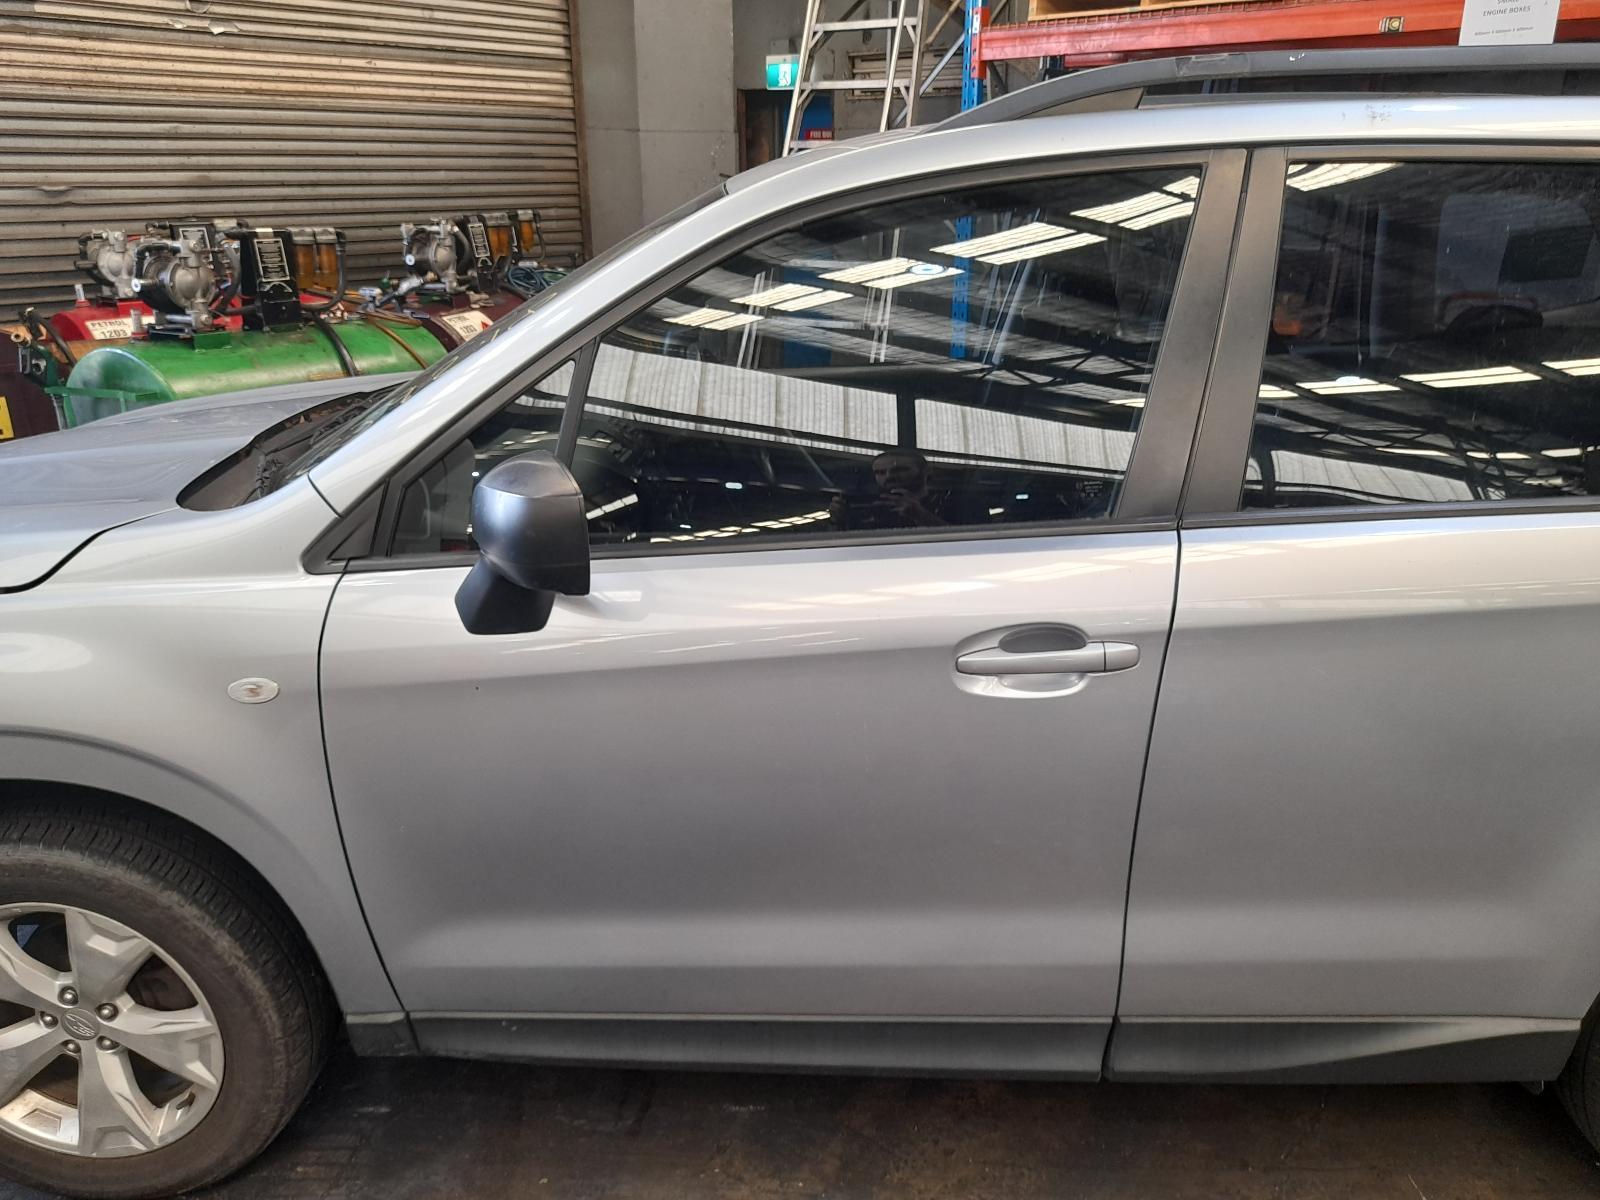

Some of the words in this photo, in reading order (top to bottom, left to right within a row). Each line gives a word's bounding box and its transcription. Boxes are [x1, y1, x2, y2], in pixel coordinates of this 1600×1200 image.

[1483, 8, 1507, 16] ENGINE
[1509, 5, 1531, 13] BOXES
[90, 320, 128, 328] PETROL
[101, 329, 128, 338] 1203
